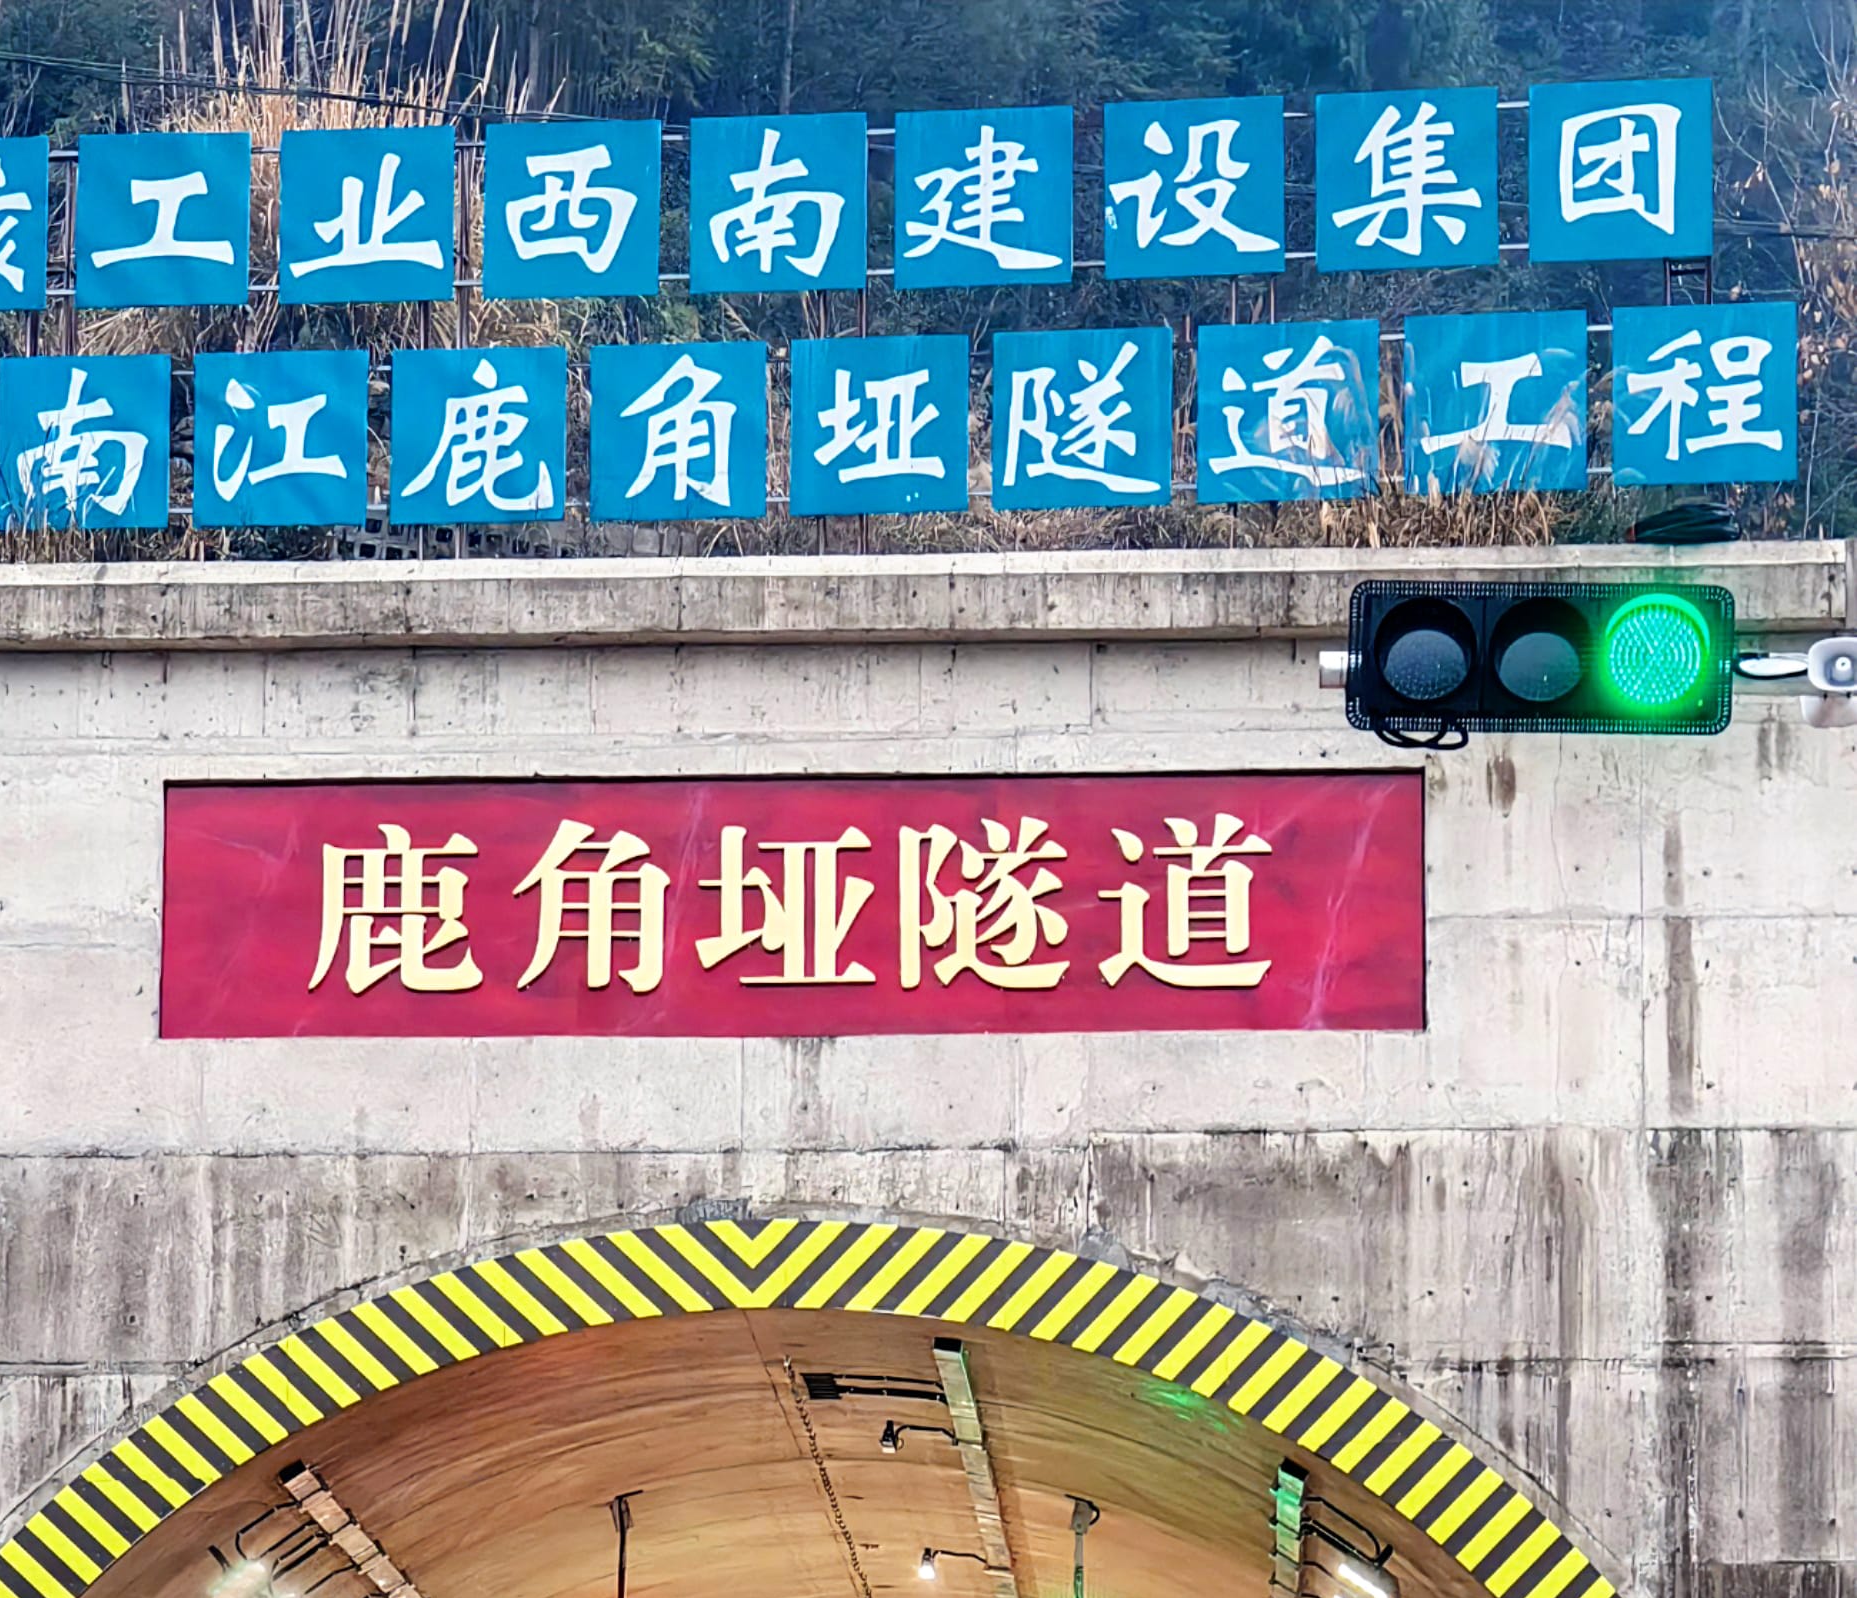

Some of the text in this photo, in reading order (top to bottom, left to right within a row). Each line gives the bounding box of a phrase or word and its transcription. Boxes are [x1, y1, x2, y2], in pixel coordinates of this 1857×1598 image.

[308, 812, 1273, 994] 鹿角垭隧道
